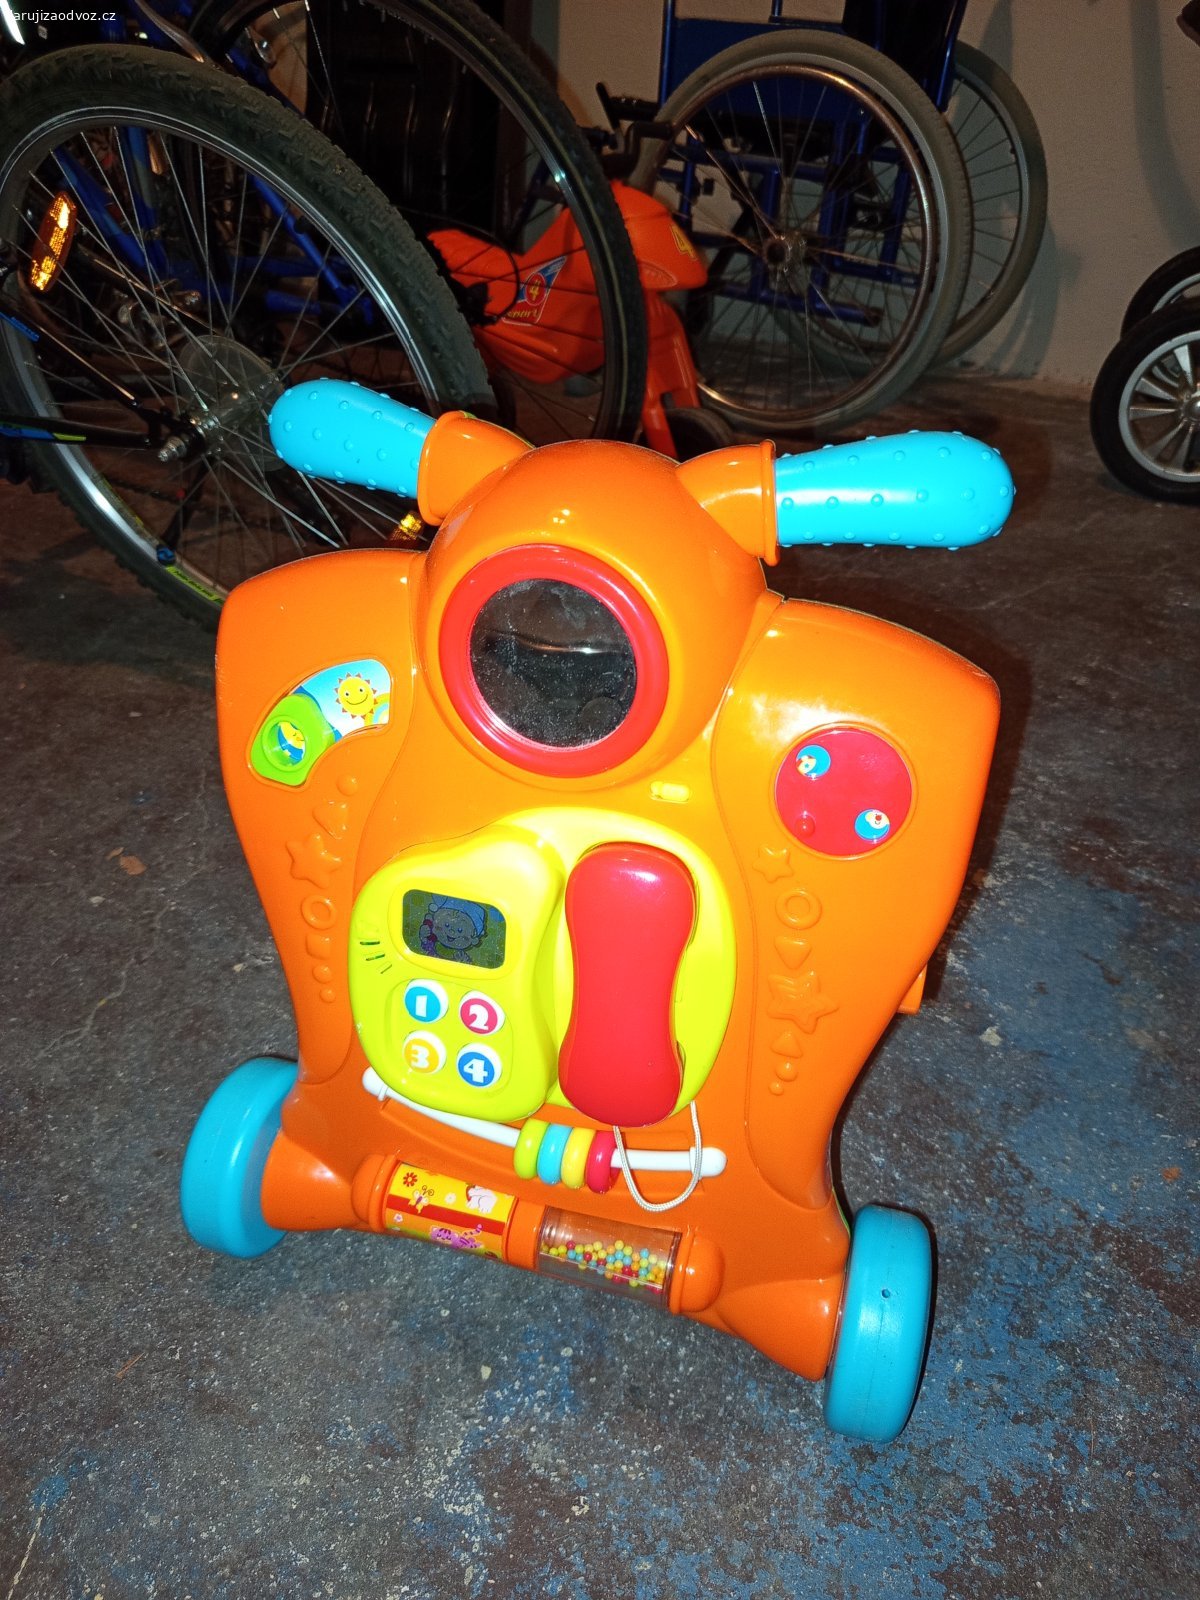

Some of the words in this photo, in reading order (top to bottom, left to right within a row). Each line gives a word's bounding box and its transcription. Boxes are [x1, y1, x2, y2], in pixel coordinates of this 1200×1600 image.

[529, 279, 541, 301] 4
[415, 994, 428, 1018] 1
[469, 1004, 489, 1031] 2
[411, 1044, 430, 1069] 3
[463, 1058, 489, 1084] 4
